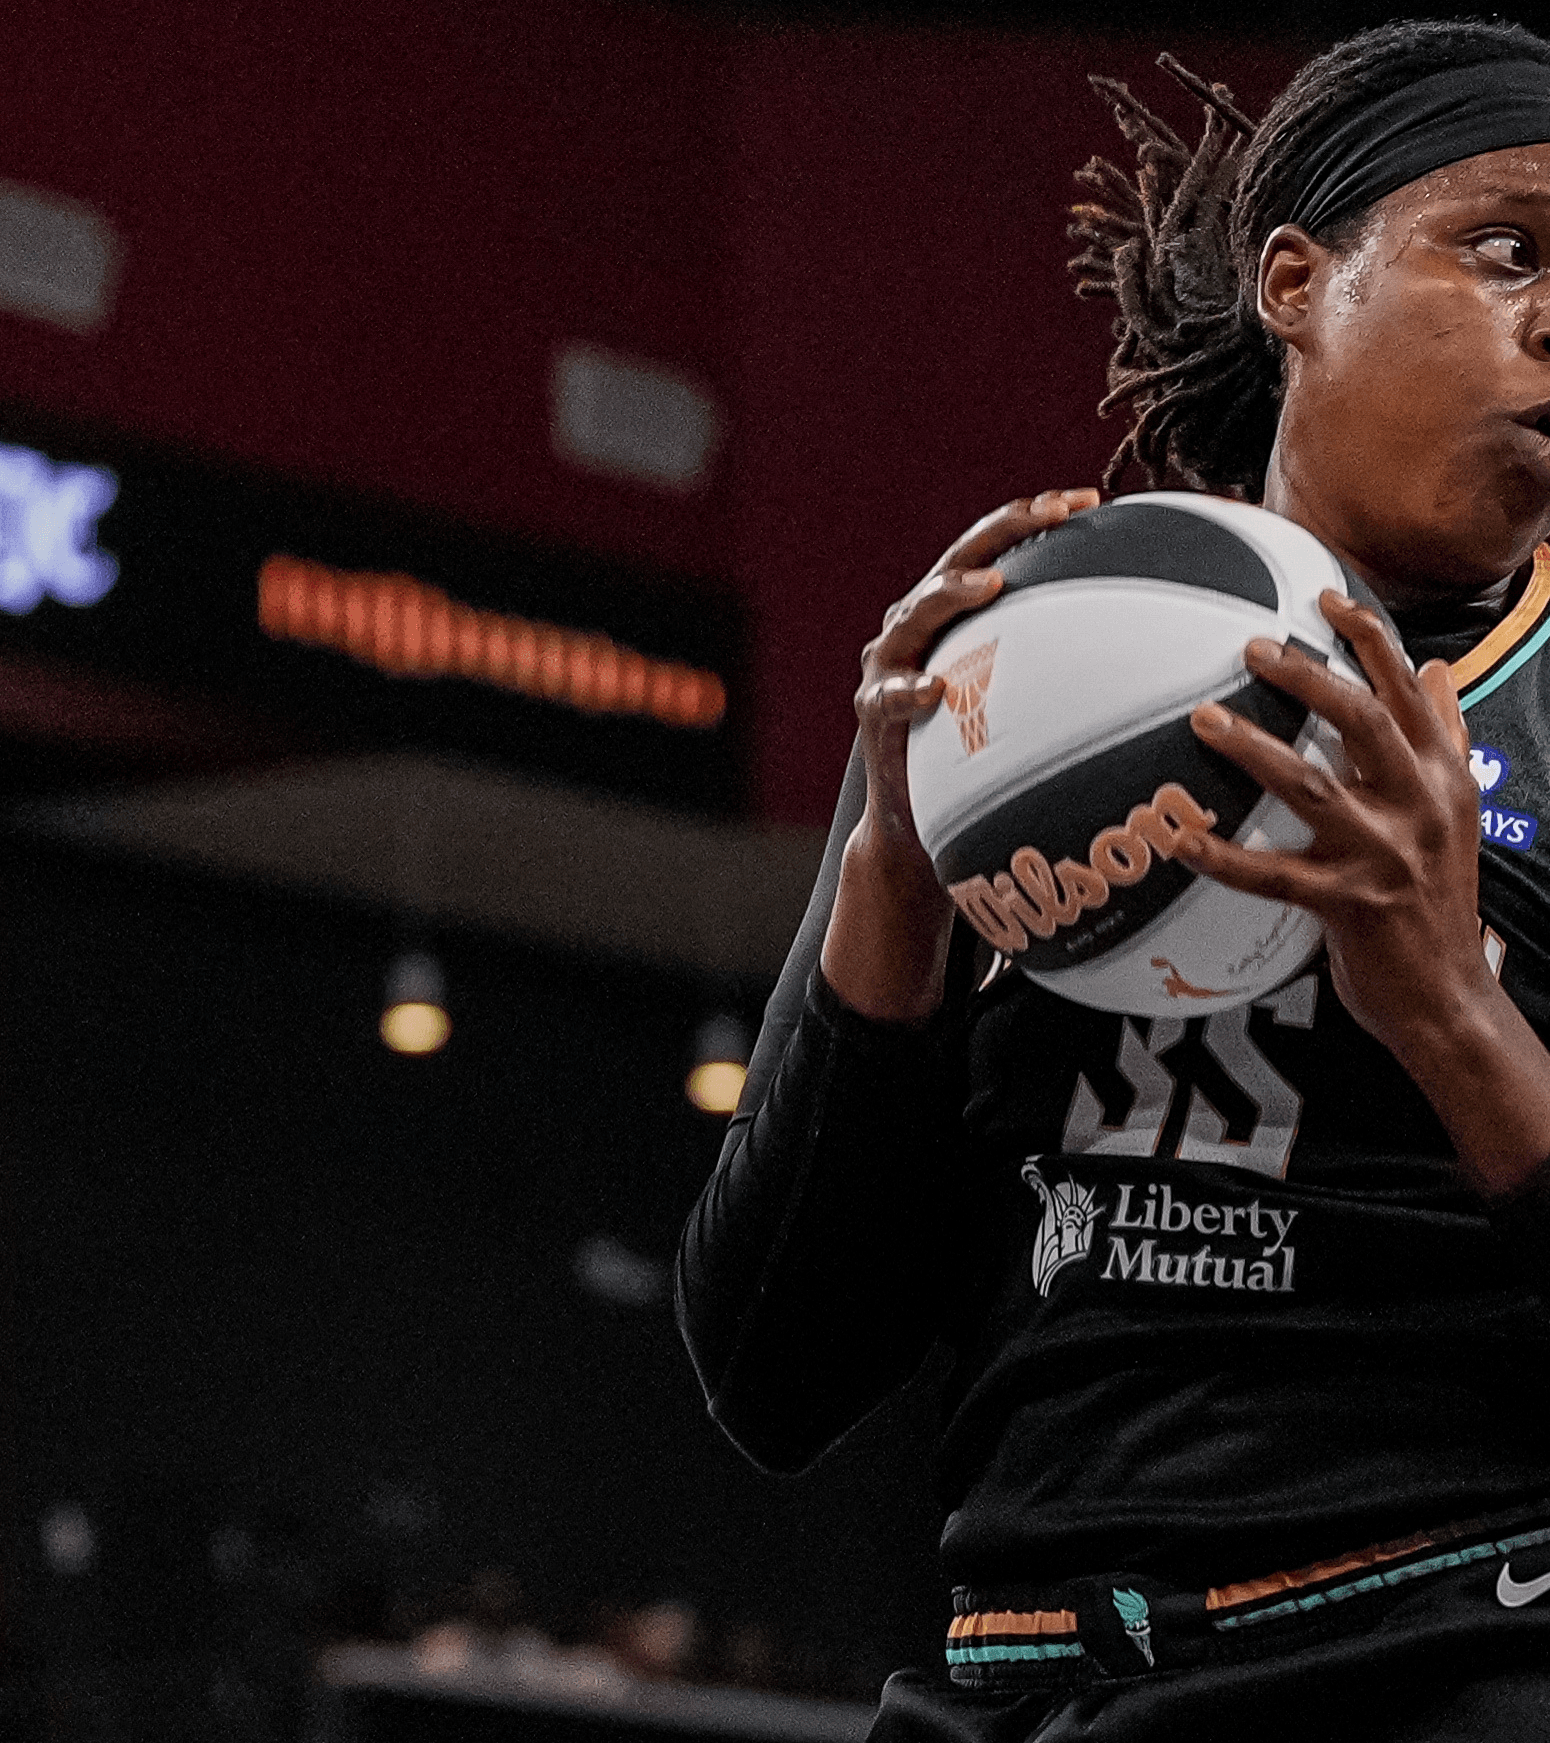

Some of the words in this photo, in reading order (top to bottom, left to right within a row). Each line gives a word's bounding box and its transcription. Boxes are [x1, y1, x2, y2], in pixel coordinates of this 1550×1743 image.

[947, 781, 1218, 953] Wilson
[1109, 1182, 1299, 1257] Liberty
[1101, 1235, 1296, 1293] Mutual
